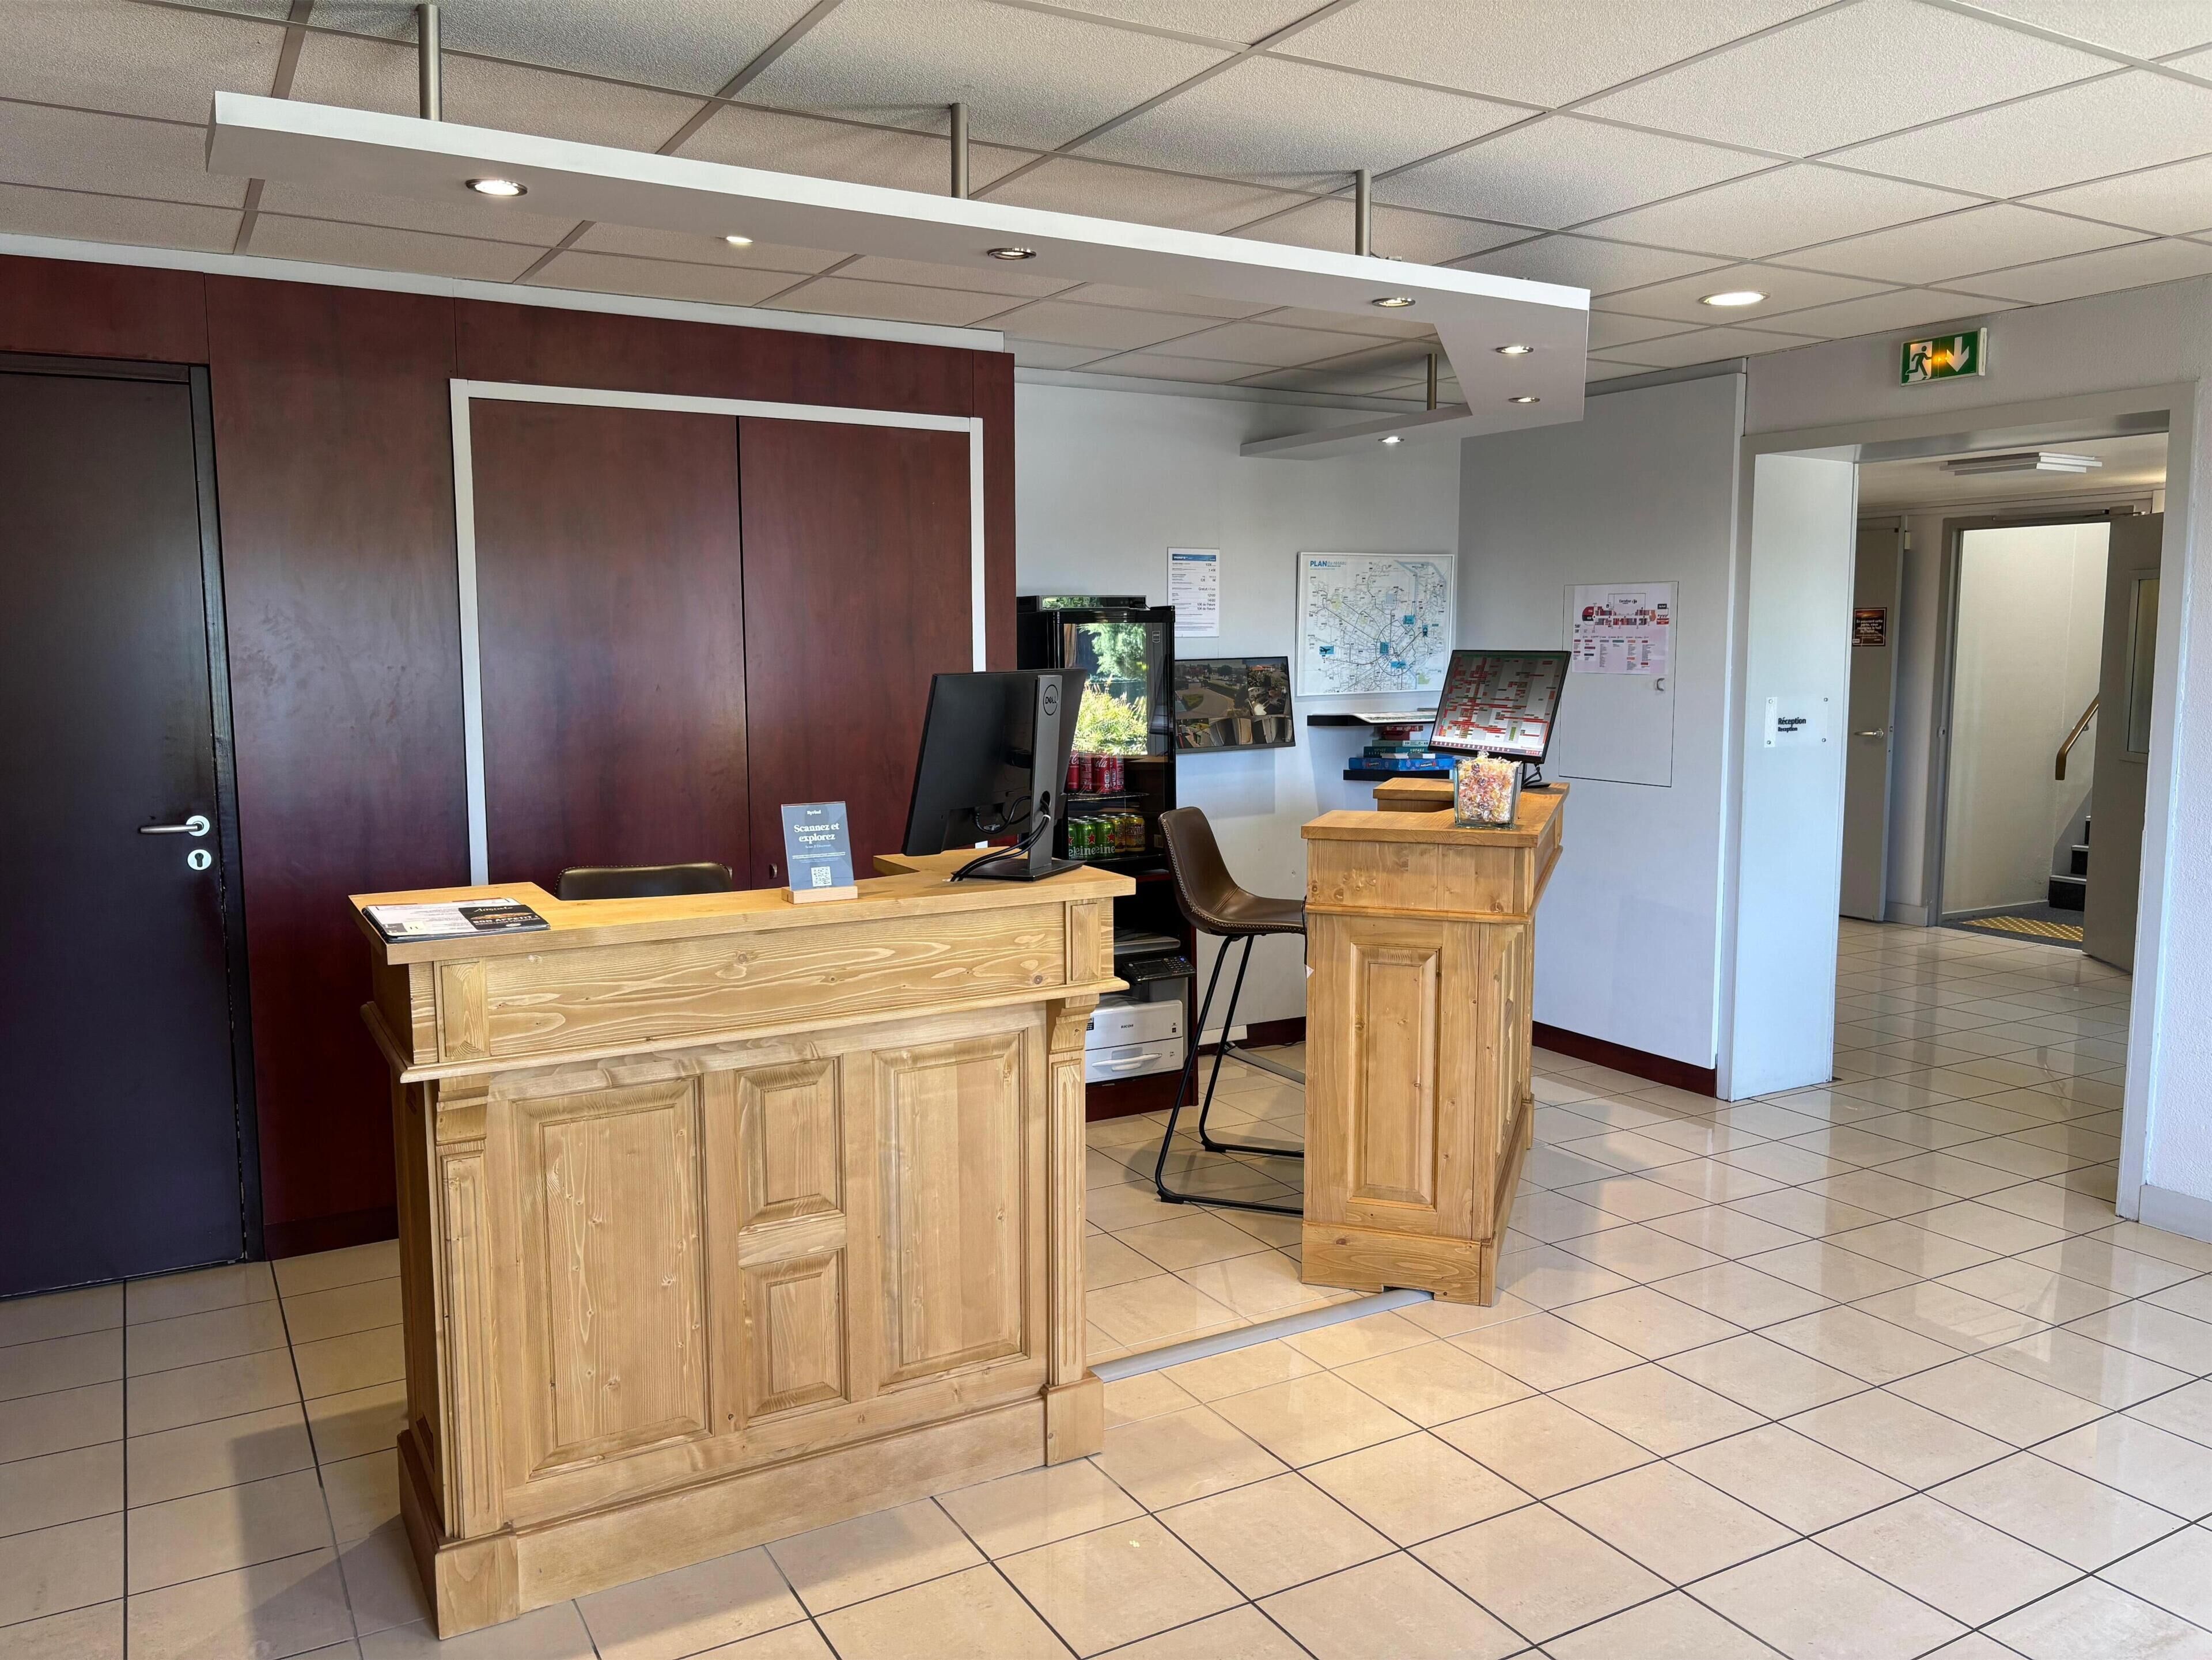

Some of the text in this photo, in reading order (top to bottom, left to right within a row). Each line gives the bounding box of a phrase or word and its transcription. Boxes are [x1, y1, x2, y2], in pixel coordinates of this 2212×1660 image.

[1045, 696, 1057, 704] DELL
[1778, 717, 1806, 727] Réception
[1095, 755, 1109, 768] ola
[794, 824, 830, 832] Scannez
[798, 833, 836, 844] explorez
